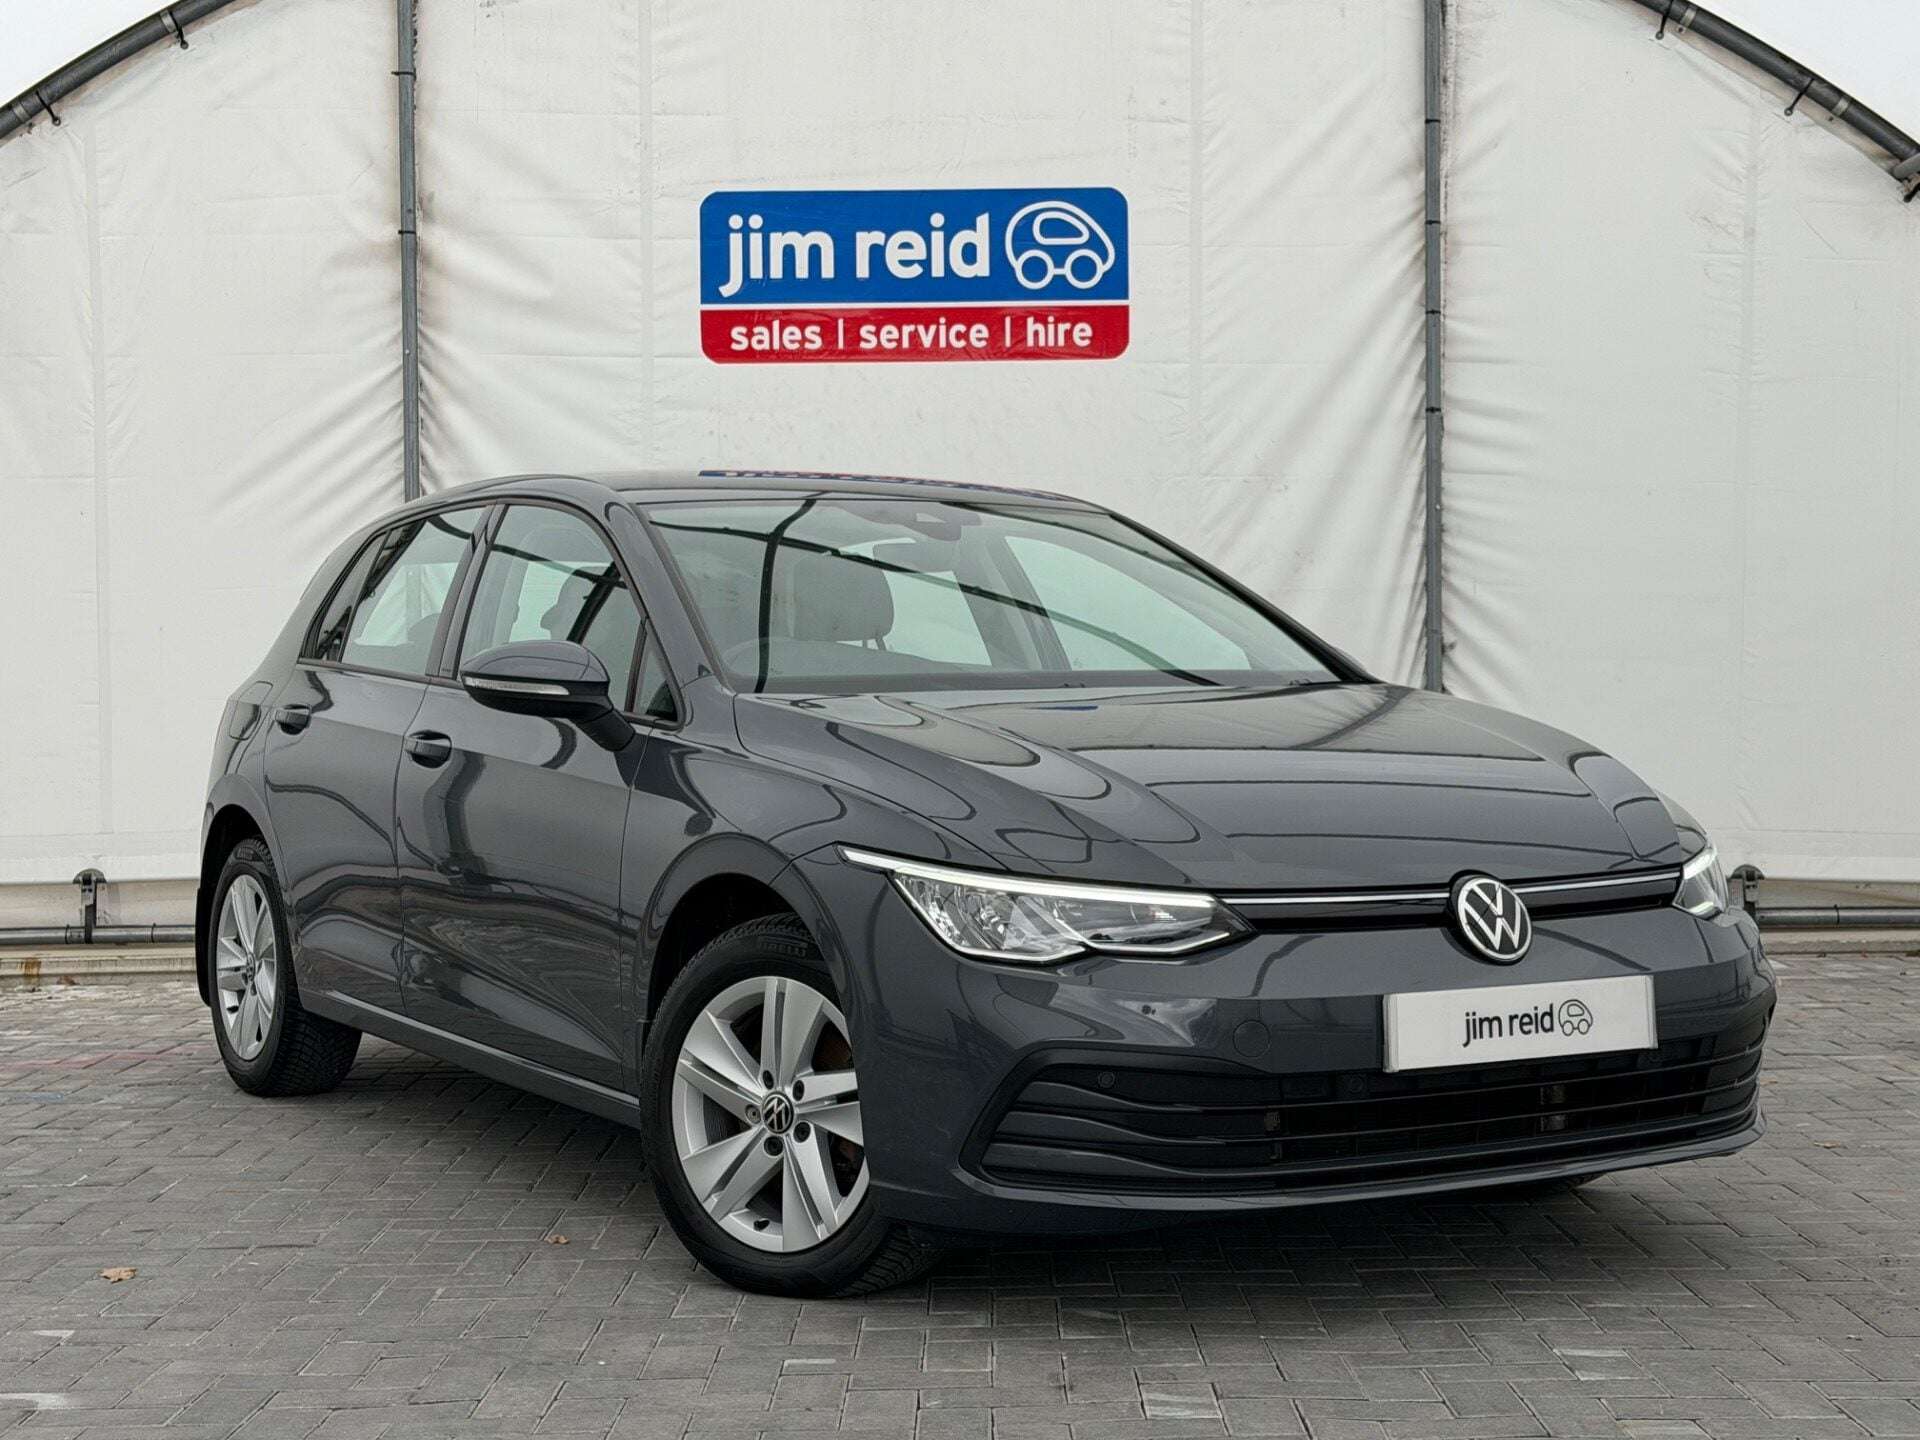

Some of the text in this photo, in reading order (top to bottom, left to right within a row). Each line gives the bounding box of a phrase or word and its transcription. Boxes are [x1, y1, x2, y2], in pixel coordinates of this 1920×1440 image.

[718, 212, 991, 298] jim reid
[729, 319, 823, 352] sales
[858, 317, 989, 351] service
[1026, 316, 1093, 348] hire
[1462, 1003, 1555, 1048] jim reid
